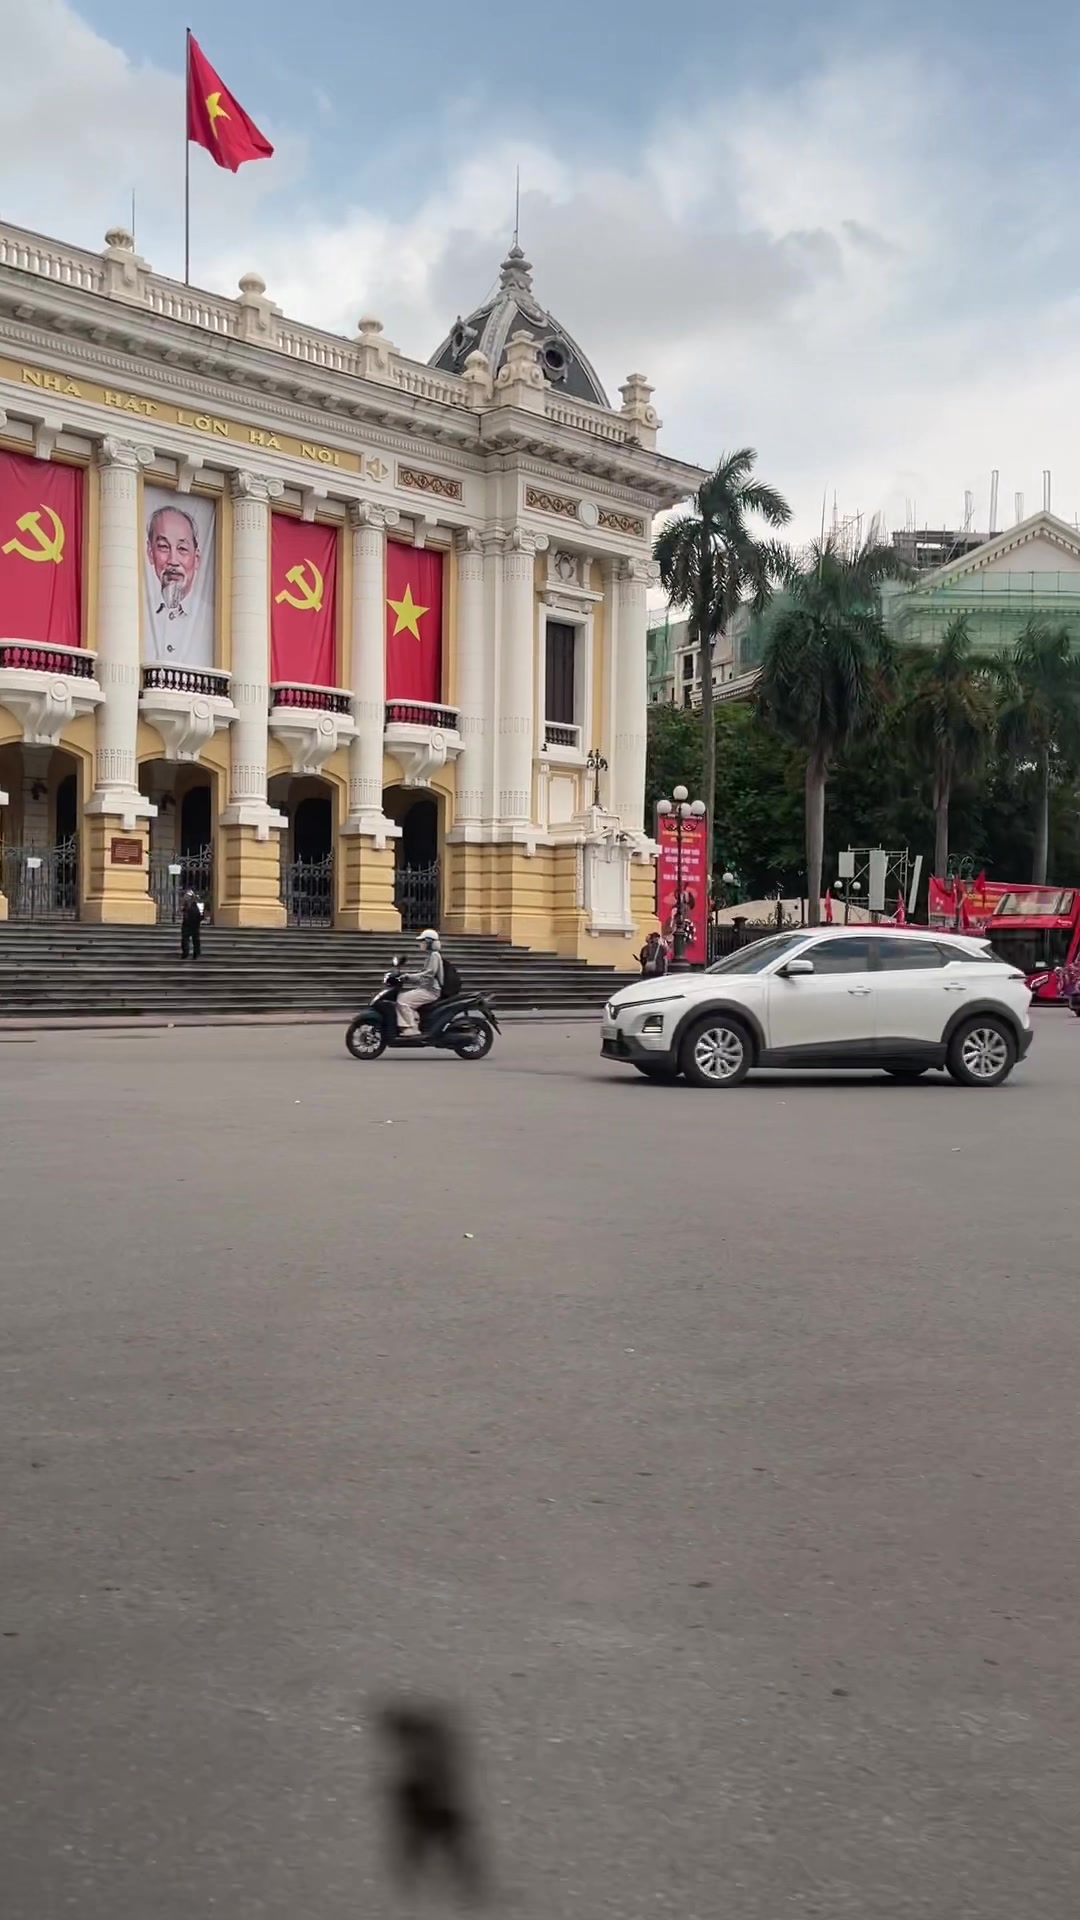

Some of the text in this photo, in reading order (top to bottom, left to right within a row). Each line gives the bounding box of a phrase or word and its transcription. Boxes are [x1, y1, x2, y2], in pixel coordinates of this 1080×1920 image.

[21, 368, 82, 398] NHÀ
[104, 391, 158, 417] HÁT
[177, 410, 229, 437] LỚN
[249, 430, 283, 451] HÀ
